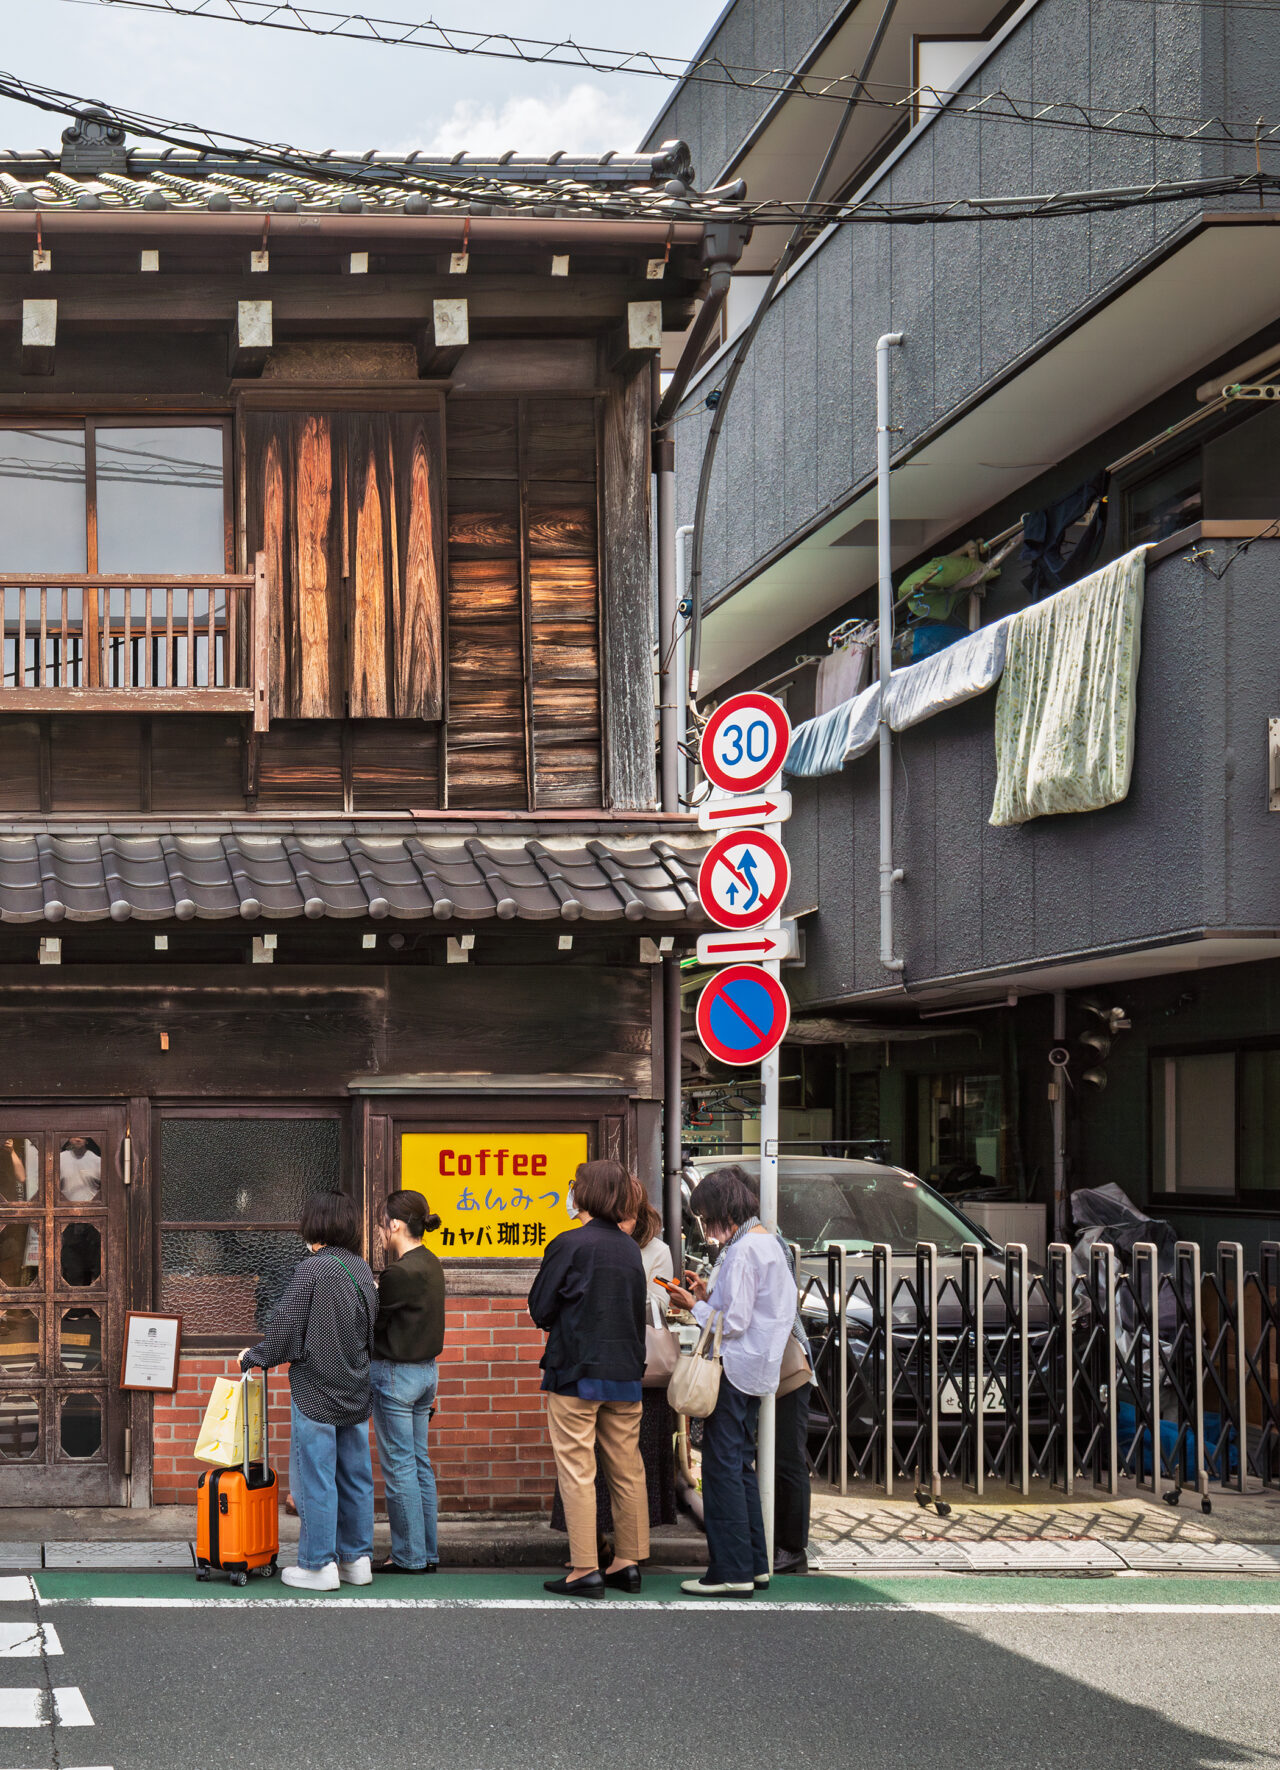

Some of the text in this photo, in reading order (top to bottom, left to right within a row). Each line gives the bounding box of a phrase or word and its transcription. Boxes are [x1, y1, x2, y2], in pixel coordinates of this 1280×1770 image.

[722, 720, 769, 766] 30
[438, 1149, 548, 1177] Coffee
[456, 1186, 561, 1211] あんみつ
